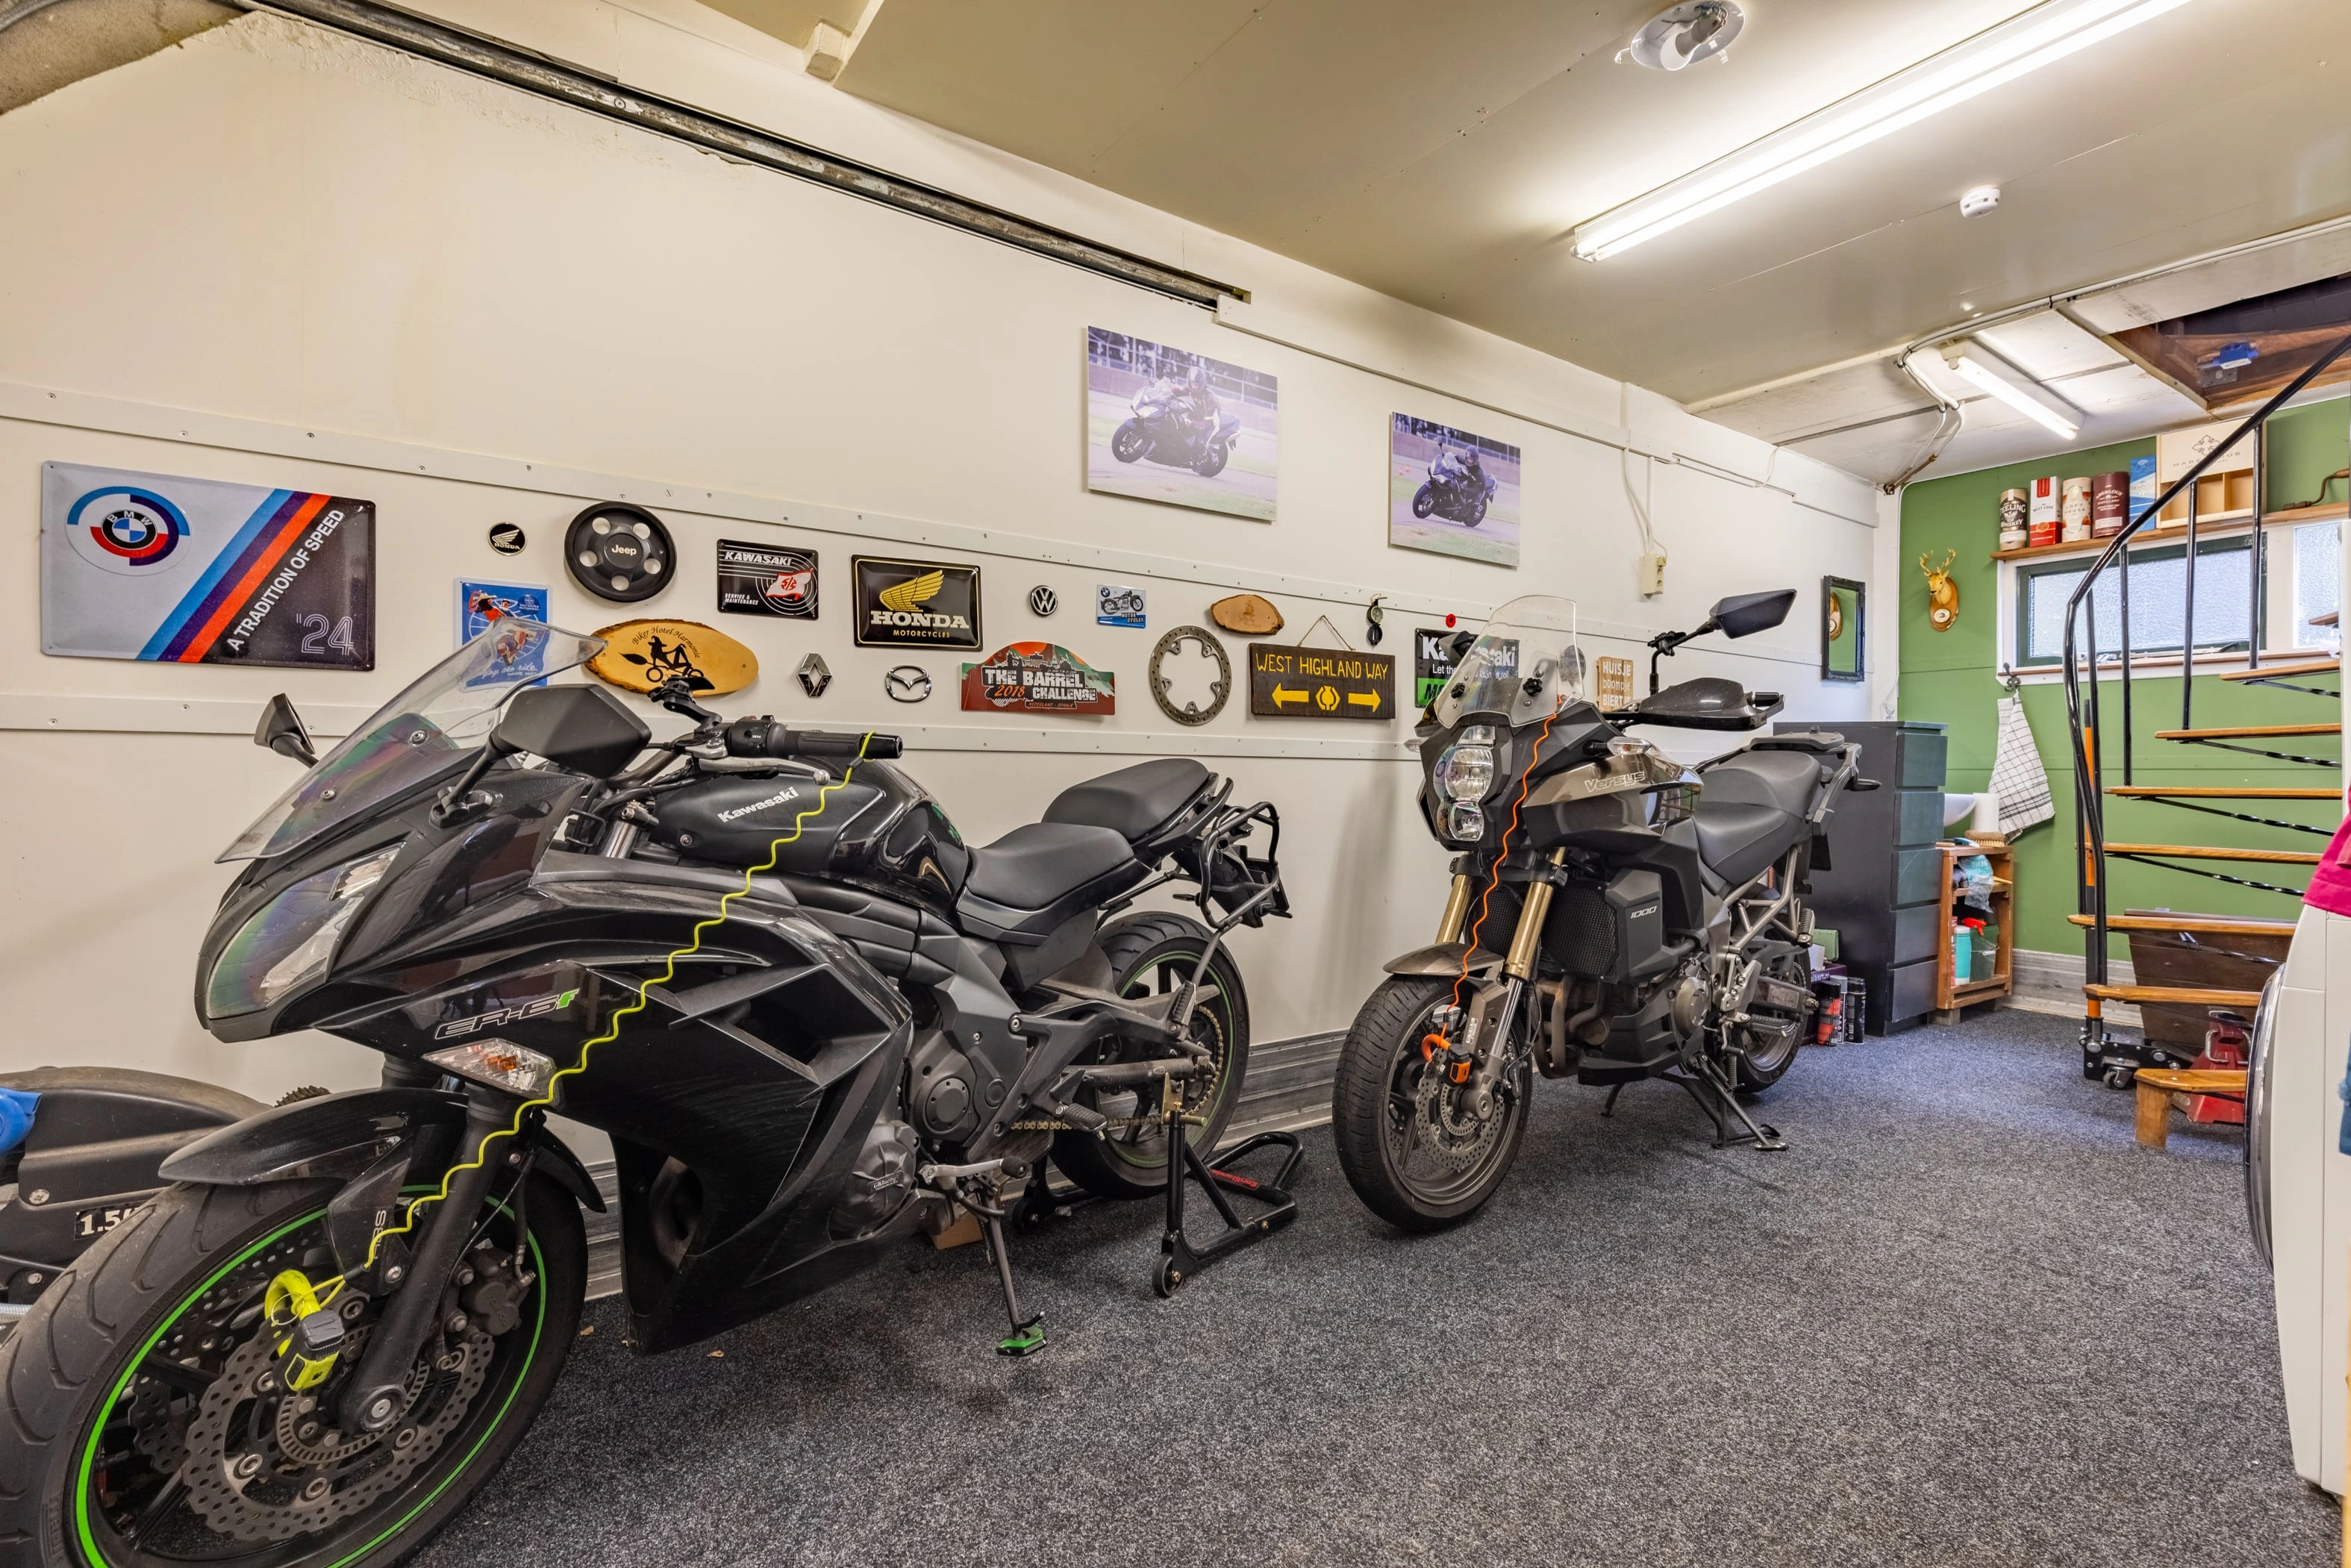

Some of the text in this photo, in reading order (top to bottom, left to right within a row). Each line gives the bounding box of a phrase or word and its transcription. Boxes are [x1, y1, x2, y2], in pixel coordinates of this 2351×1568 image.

[107, 510, 152, 525] BMW
[611, 544, 637, 556] Jeep
[725, 552, 792, 566] KAWASAKI
[227, 510, 345, 651] A TRADITION OF SPEED
[871, 610, 970, 628] HONDA
[632, 625, 700, 658] Biker Hotel Harmonie
[893, 630, 950, 638] MOTORCYCLES
[1423, 637, 1515, 666] Kaasaki
[1256, 653, 1388, 680] WEST HIGHLAND WAY
[1433, 663, 1445, 674] Let
[1603, 661, 1631, 676] HUISJE
[984, 669, 1083, 687] THE BARREL
[1603, 678, 1631, 692] boompje
[994, 684, 1025, 697] 2018
[1032, 687, 1096, 700] CHALLENGE
[1584, 771, 1645, 793] Versys
[717, 786, 799, 823] Kawasaki
[1630, 905, 1657, 919] 1000
